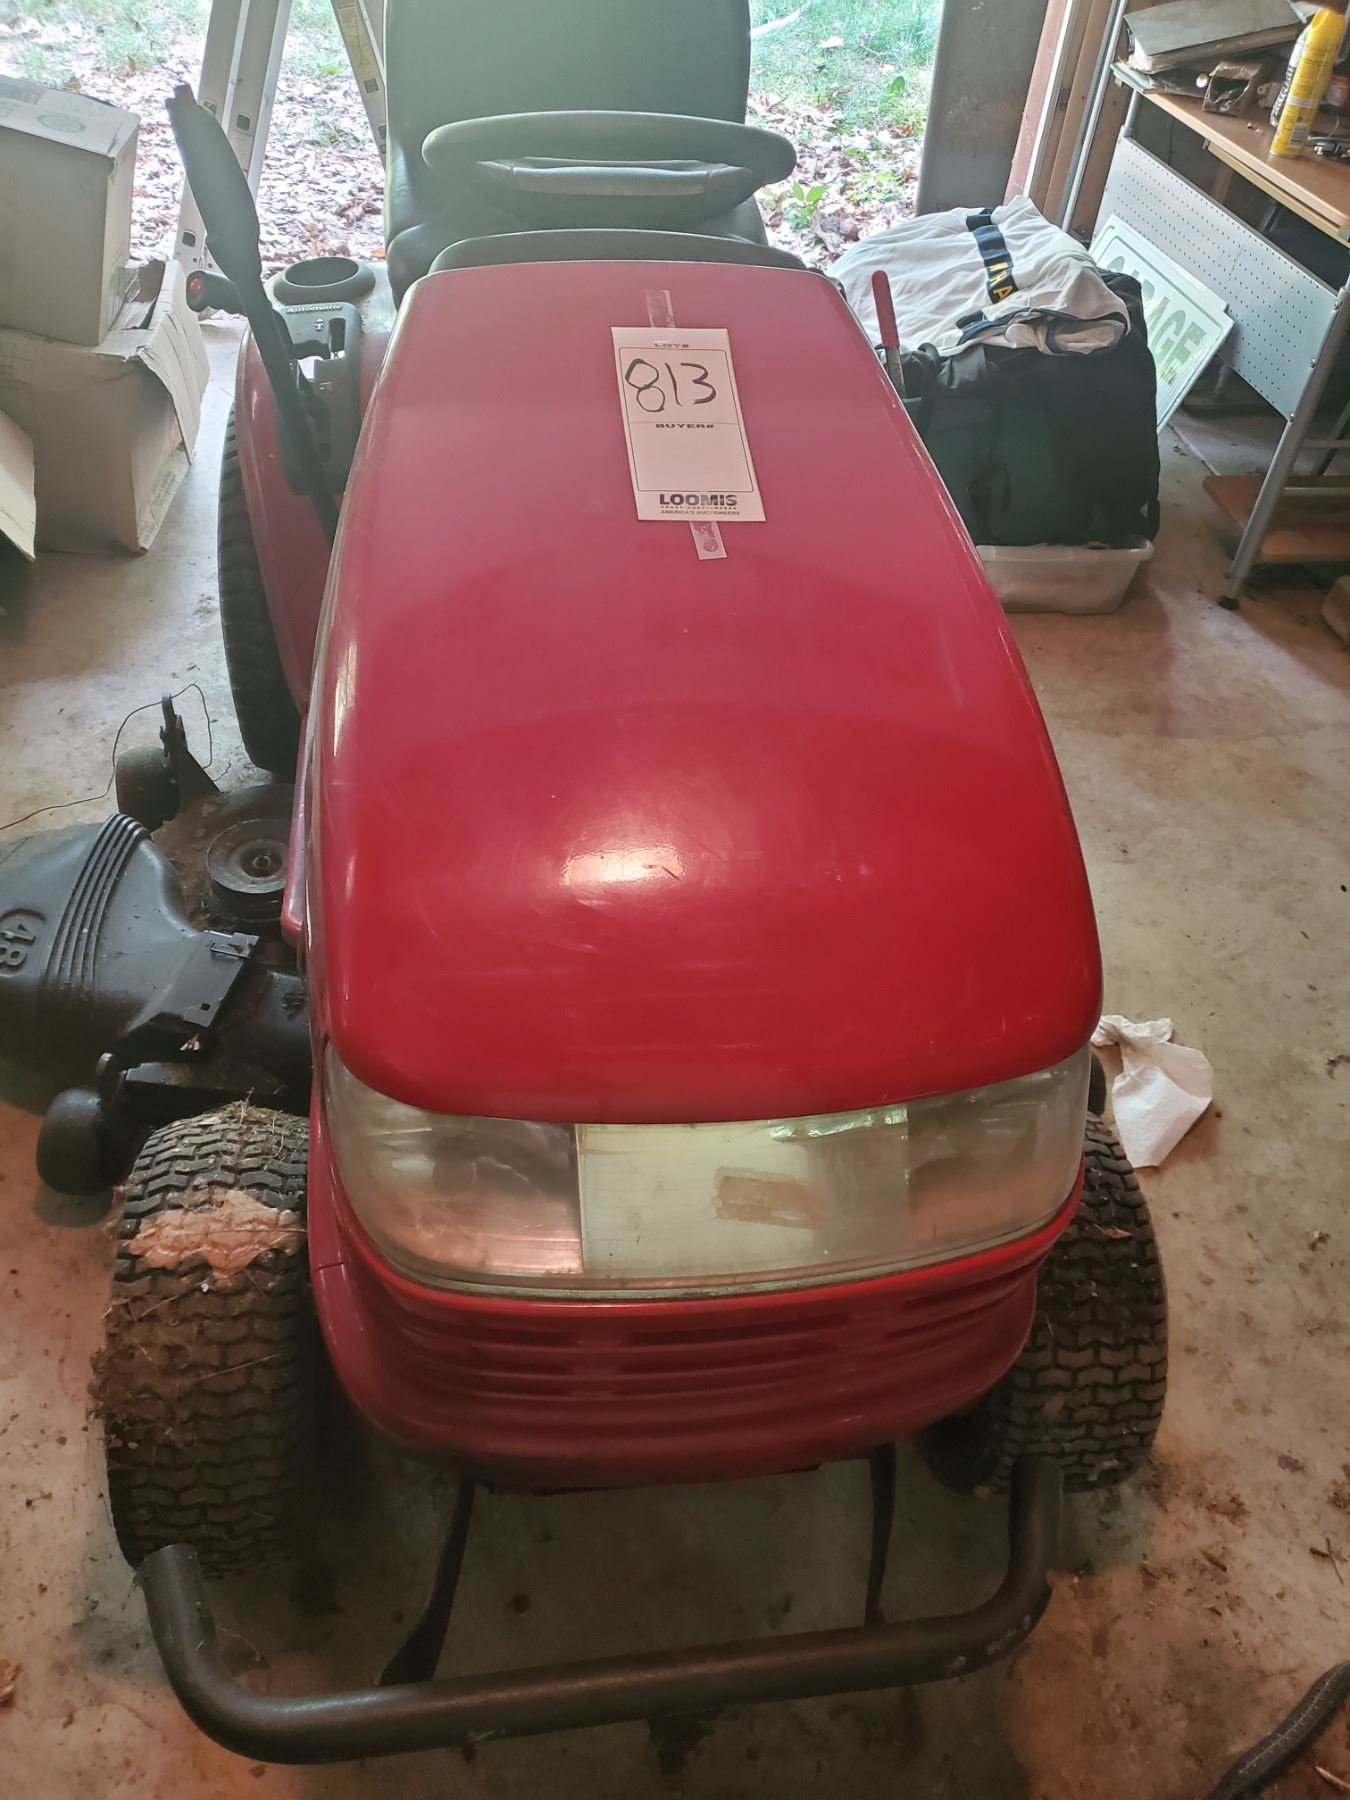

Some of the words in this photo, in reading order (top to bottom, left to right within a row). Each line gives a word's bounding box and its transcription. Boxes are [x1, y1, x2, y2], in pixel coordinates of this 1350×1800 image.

[286, 304, 343, 314] Automatic
[624, 358, 717, 412] 813
[659, 493, 738, 506] LOOMIS
